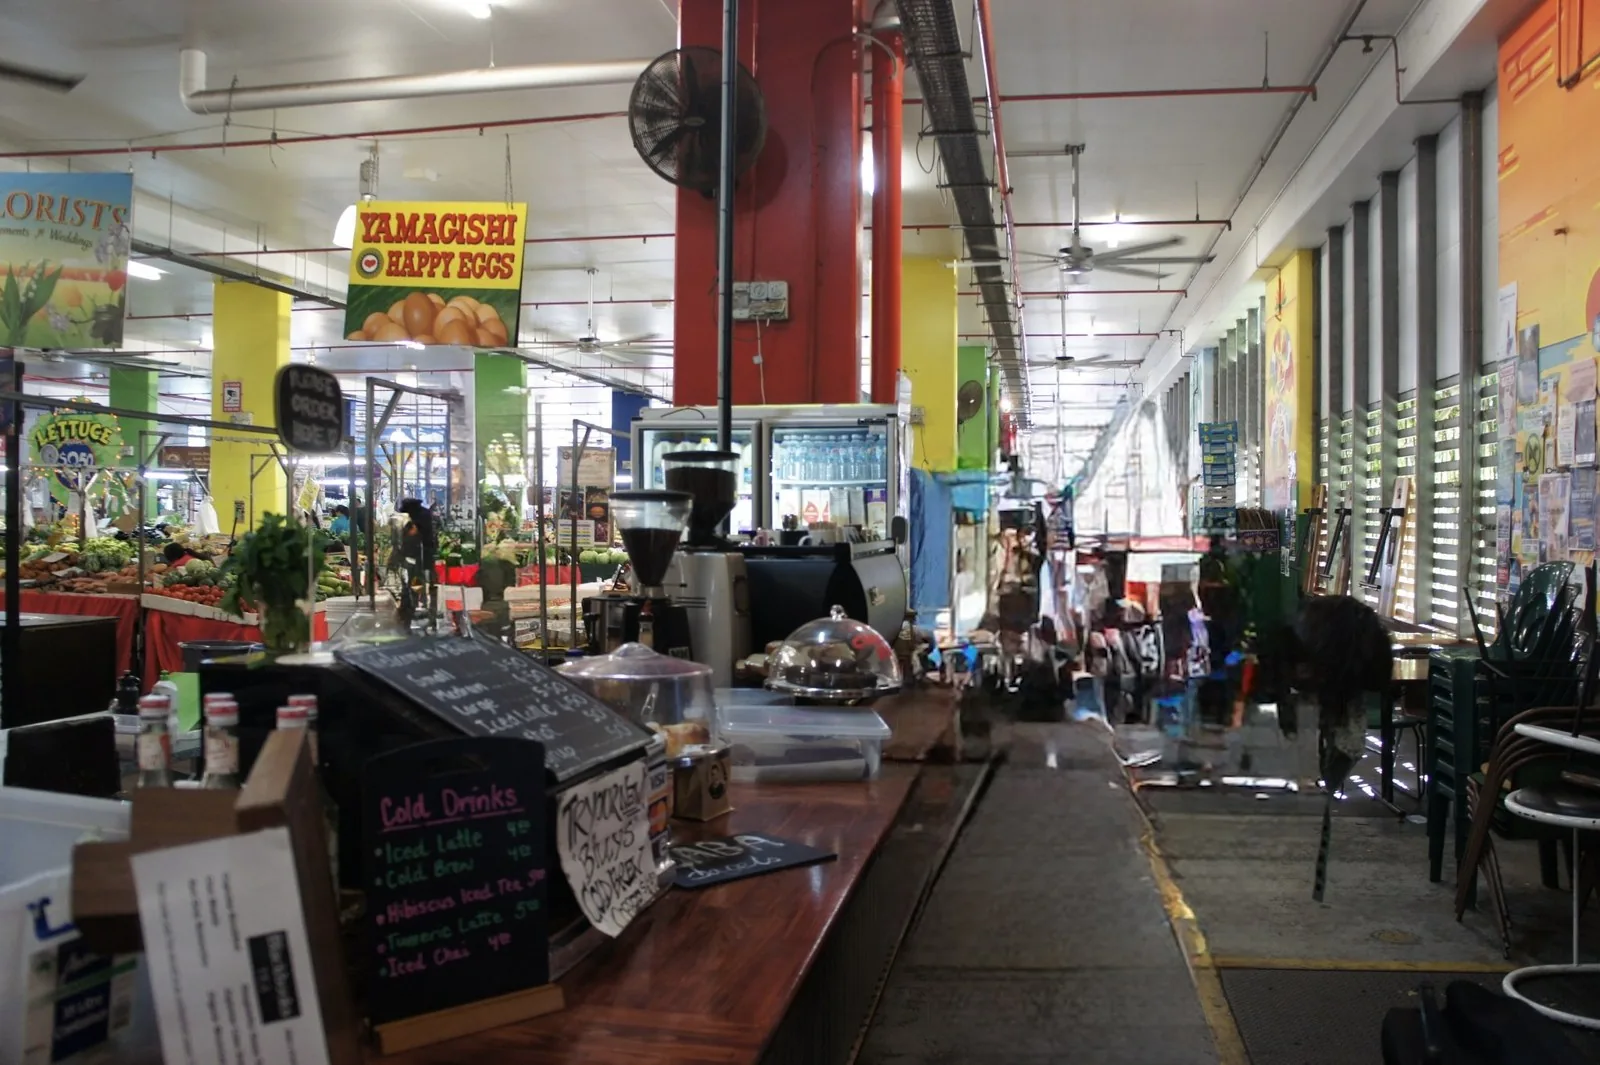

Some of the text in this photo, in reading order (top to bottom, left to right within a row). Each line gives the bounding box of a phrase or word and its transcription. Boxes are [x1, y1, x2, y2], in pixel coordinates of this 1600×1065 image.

[0, 191, 129, 233] ORISTS
[360, 212, 517, 246] YAMAGISHI
[49, 228, 93, 252] Weddings
[386, 250, 515, 279] HAPPY EGGS
[36, 421, 113, 452] LETTUCE
[380, 783, 517, 827] Cold Drinks
[385, 838, 430, 863] Iced
[436, 828, 483, 852] Latte
[386, 865, 428, 888] Cold
[434, 858, 474, 878] Brew
[387, 896, 456, 923] Hibiscus
[460, 883, 495, 903] Iced
[458, 912, 503, 934] Latte
[388, 952, 427, 978] Iced
[433, 940, 471, 965] Chai
